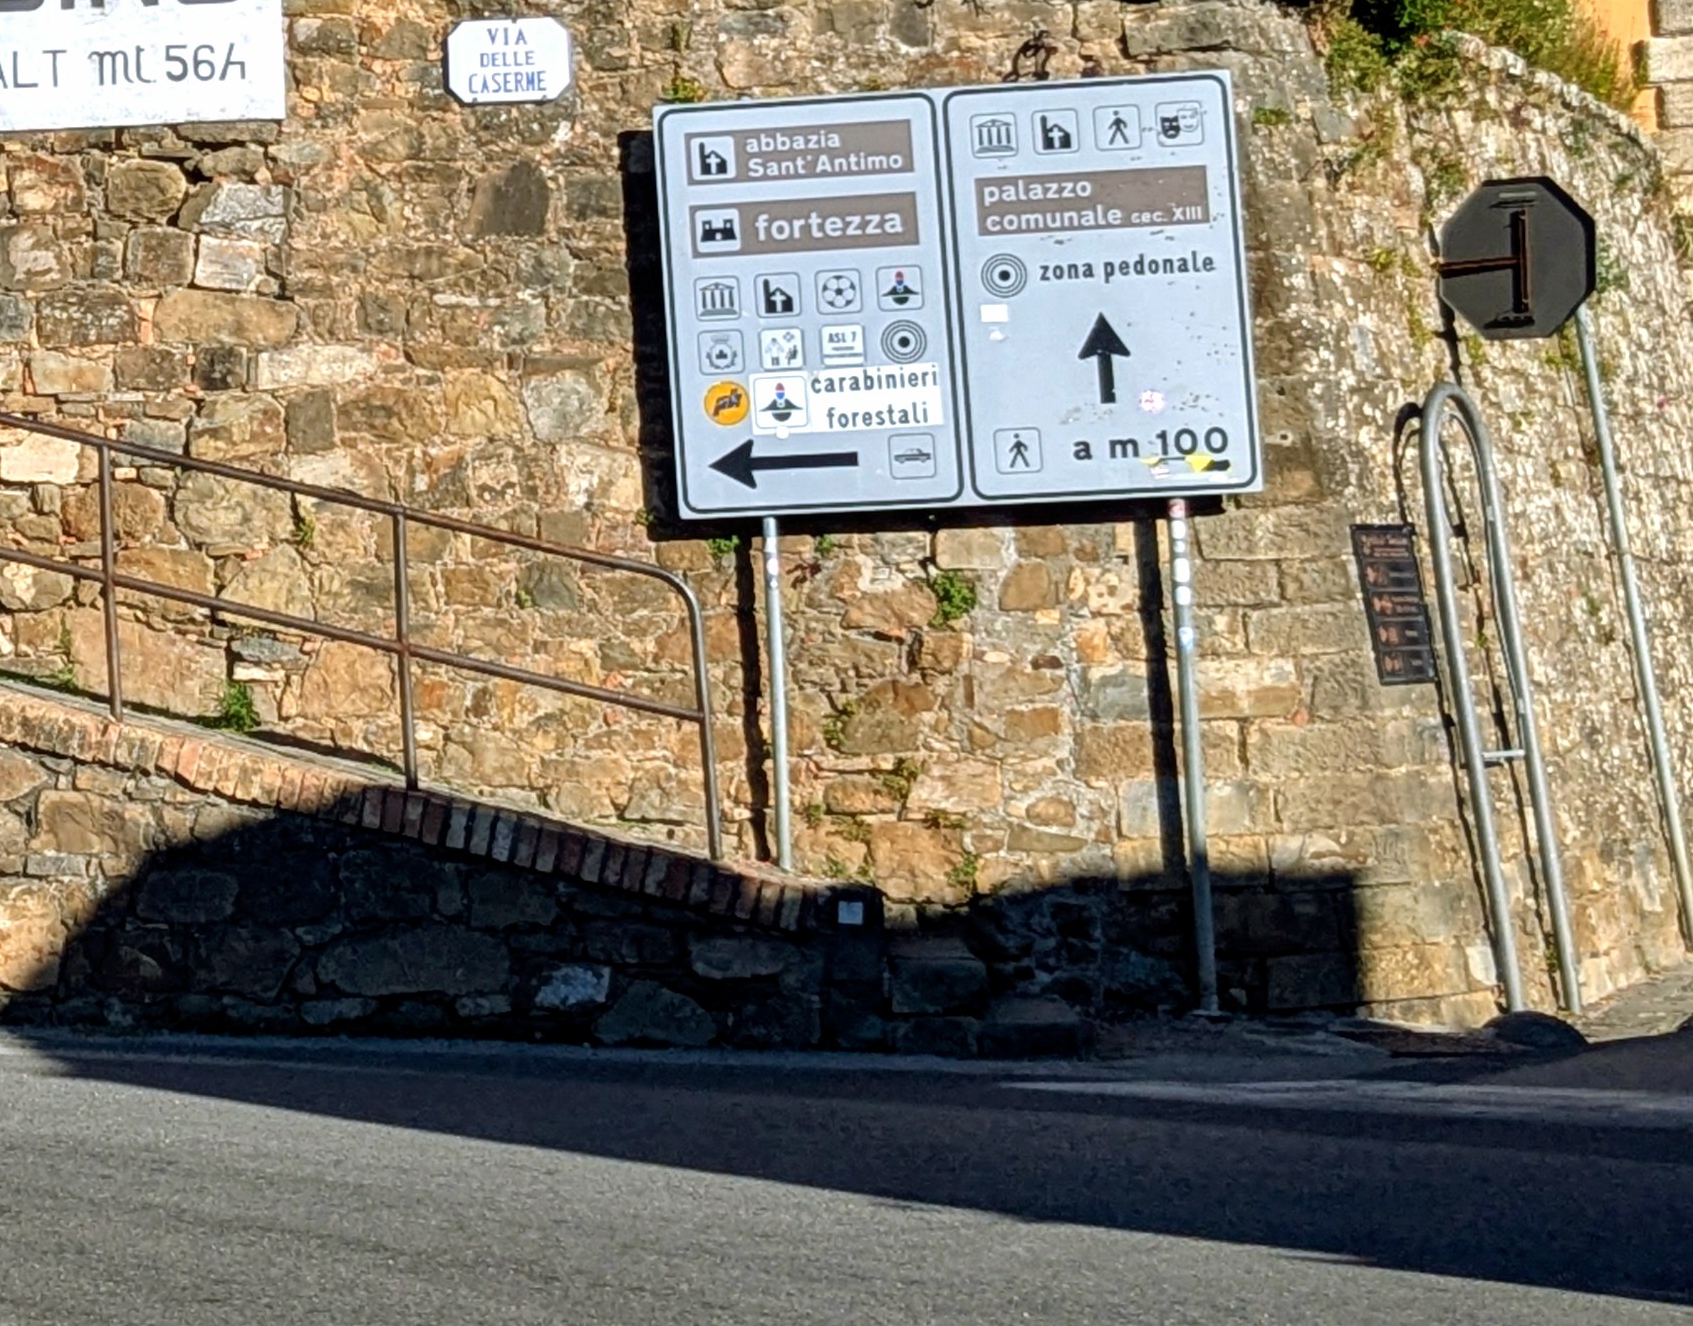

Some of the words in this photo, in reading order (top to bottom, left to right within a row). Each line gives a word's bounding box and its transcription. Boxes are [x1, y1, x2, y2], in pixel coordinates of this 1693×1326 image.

[487, 27, 528, 46] VIA
[480, 50, 535, 68] DELLE
[468, 70, 547, 94] CASERME
[746, 130, 841, 153] abbazia
[983, 179, 1092, 206] palazzo
[755, 212, 904, 242] fortezza
[986, 205, 1123, 231] comunale
[1172, 206, 1203, 222] XIII
[1039, 261, 1095, 281] zona
[1104, 250, 1216, 284] pedonale
[828, 332, 846, 343] ASL
[811, 364, 938, 394] carabinieri
[826, 401, 928, 429] forestali
[1073, 440, 1093, 460] a
[1109, 438, 1139, 458] m
[1156, 427, 1228, 455] 100
